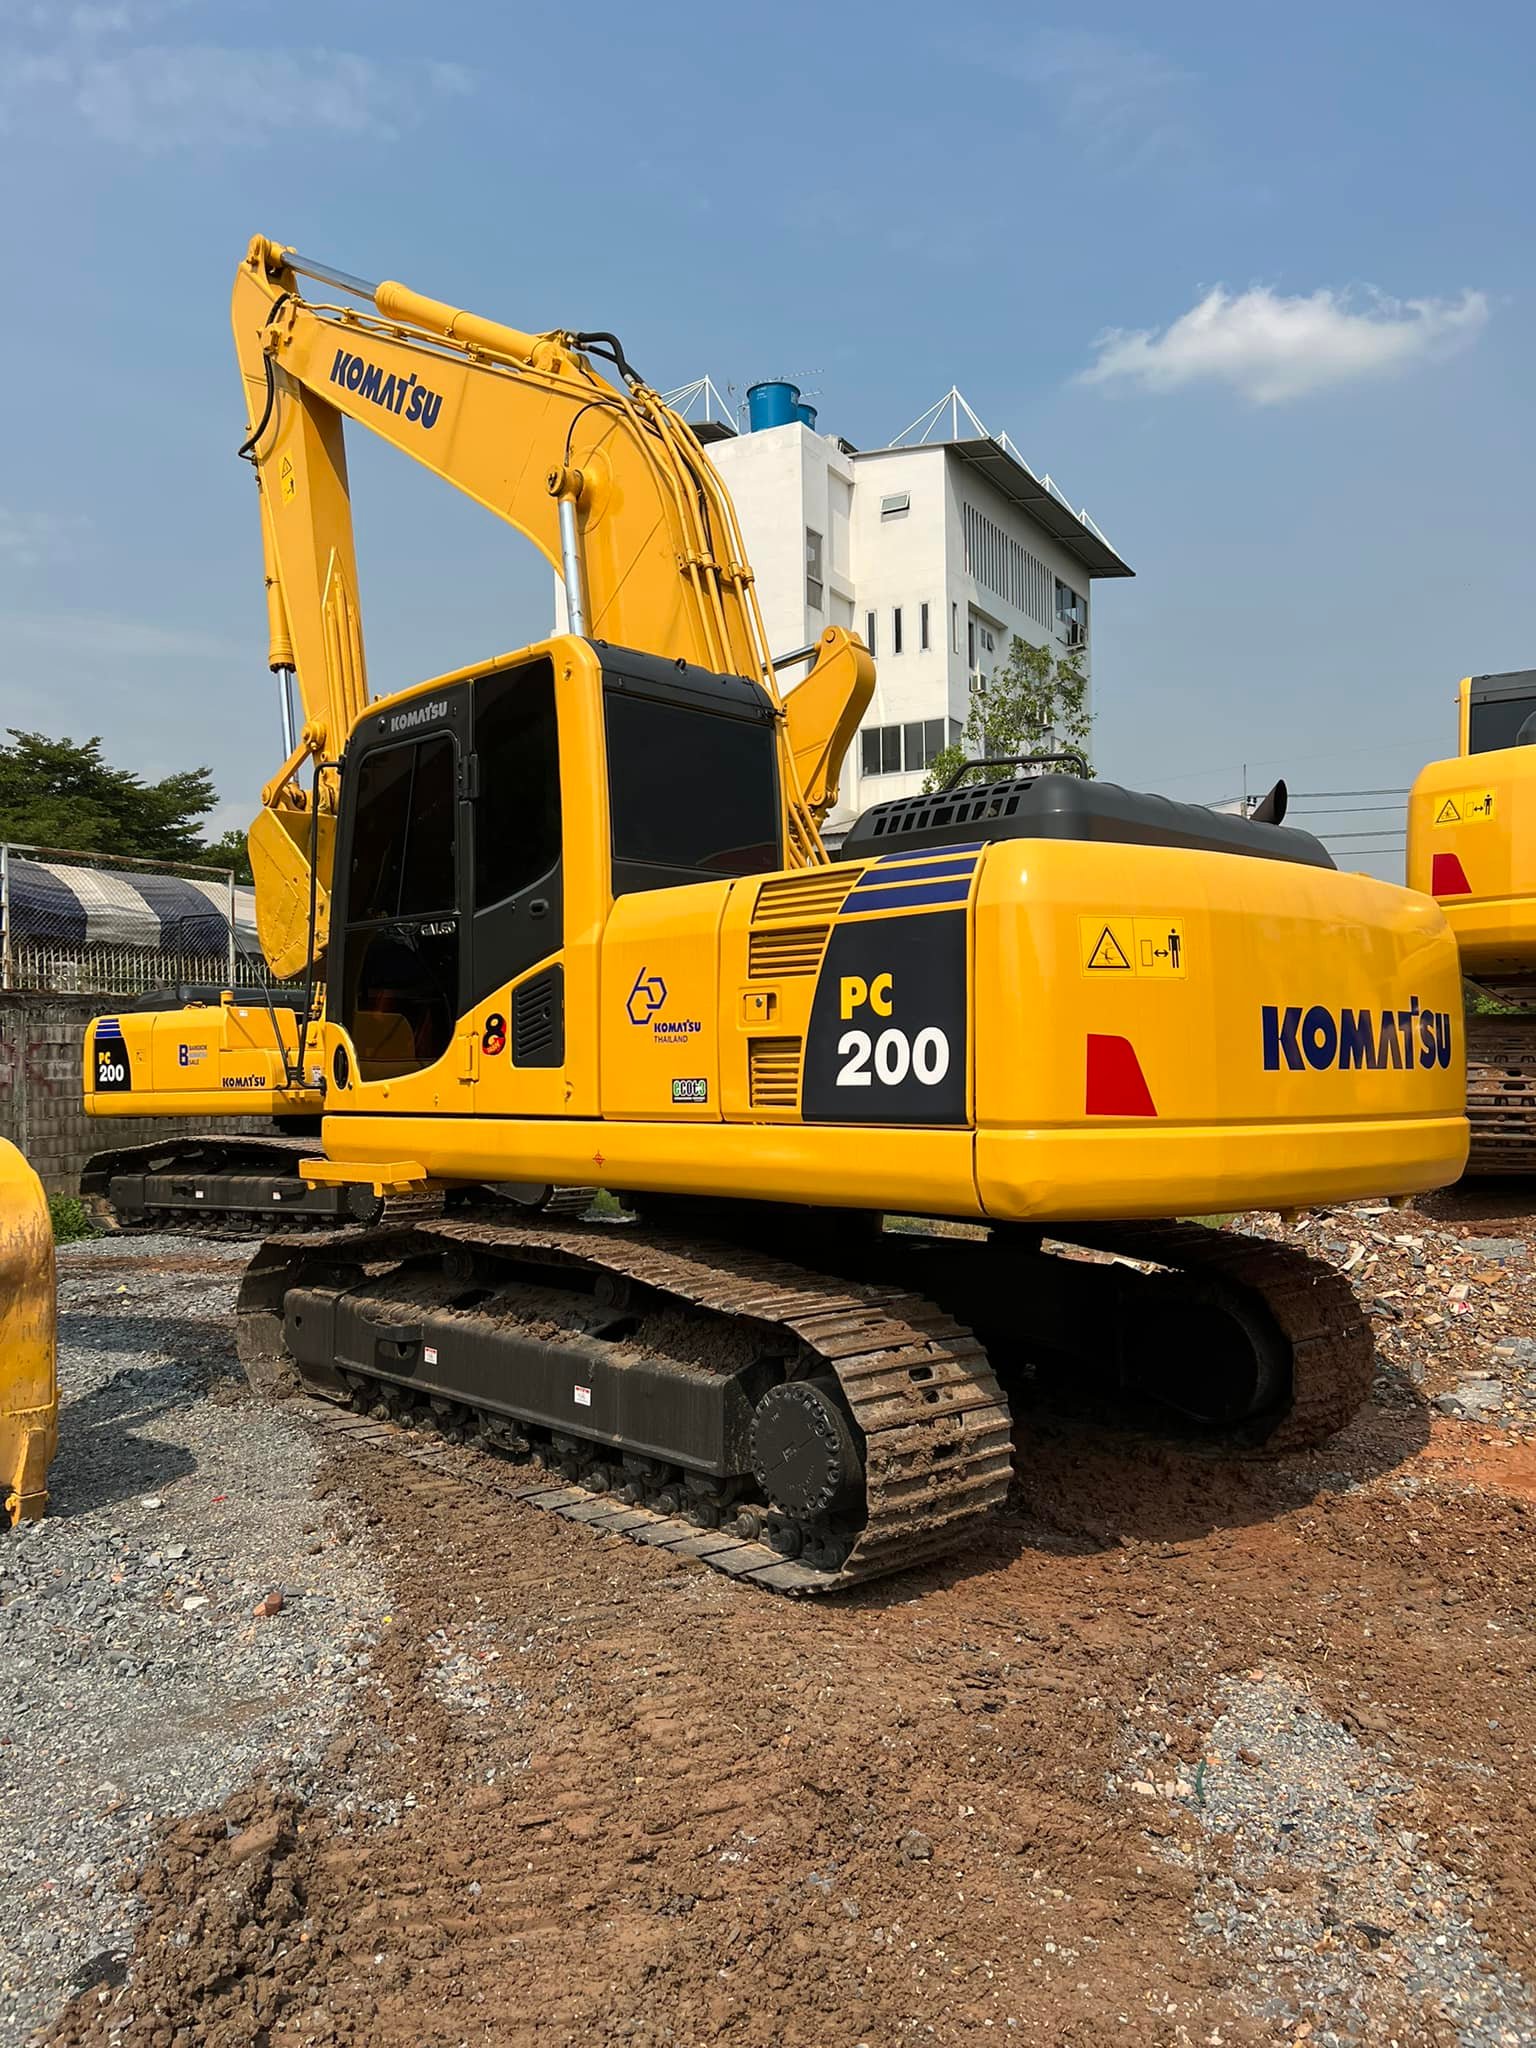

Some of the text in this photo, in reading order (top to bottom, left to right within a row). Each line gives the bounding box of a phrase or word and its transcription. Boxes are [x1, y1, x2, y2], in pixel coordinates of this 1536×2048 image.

[330, 349, 443, 429] KOMATSU
[391, 701, 448, 732] KOMATSU
[840, 972, 893, 1020] PC
[654, 1019, 702, 1033] KOMATSU
[1261, 995, 1451, 1071] KOMATSU
[654, 1035, 689, 1043] THAILAND
[98, 1051, 111, 1065] PC
[179, 1044, 189, 1066] B
[836, 1026, 950, 1086] 200
[99, 1064, 124, 1082] 200
[222, 1074, 266, 1088] KOMATSU
